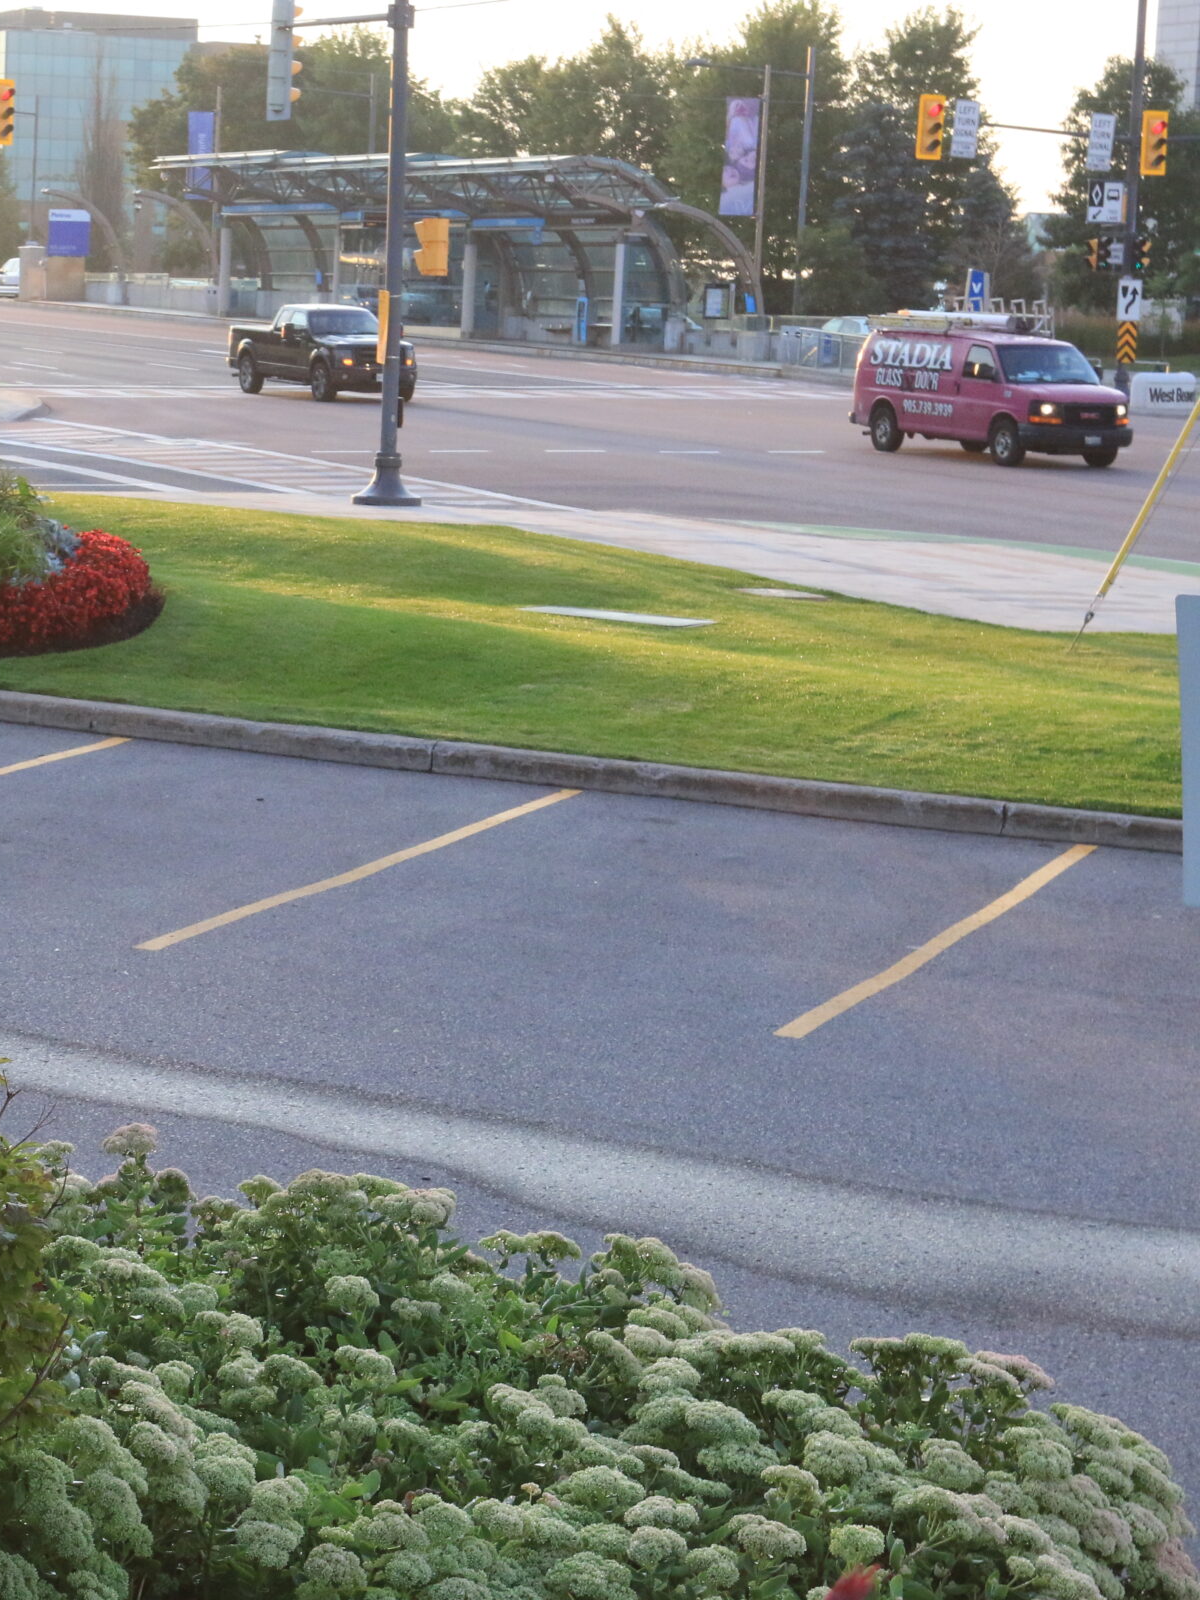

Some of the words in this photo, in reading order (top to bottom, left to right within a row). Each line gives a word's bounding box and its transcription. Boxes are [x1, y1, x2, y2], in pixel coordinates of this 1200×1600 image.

[959, 105, 977, 115] LEFT
[957, 117, 976, 128] TURN
[1094, 119, 1111, 129] LEFT
[953, 128, 975, 139] SIGNAL
[1093, 129, 1111, 140] TURN
[870, 338, 953, 371] STADIA
[875, 367, 903, 387] GLASS
[1149, 387, 1175, 402] West
[903, 398, 954, 418] 905.739.3939
